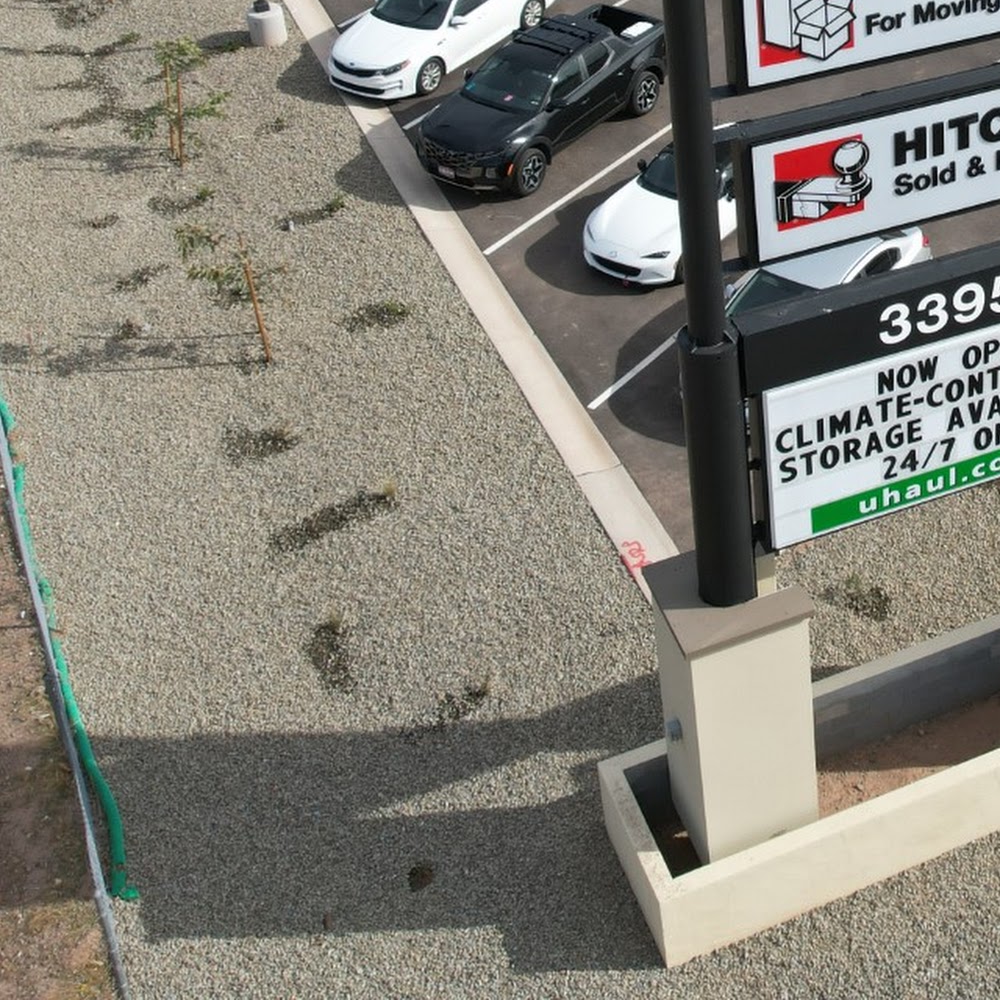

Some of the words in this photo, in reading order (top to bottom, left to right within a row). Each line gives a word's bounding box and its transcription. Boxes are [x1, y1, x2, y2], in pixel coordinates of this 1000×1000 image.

[865, 10, 905, 36] For
[894, 166, 956, 197] Sold
[966, 156, 986, 178] &
[877, 355, 939, 395] NOW
[779, 418, 923, 484] STORAGE
[883, 438, 957, 481] 24/7
